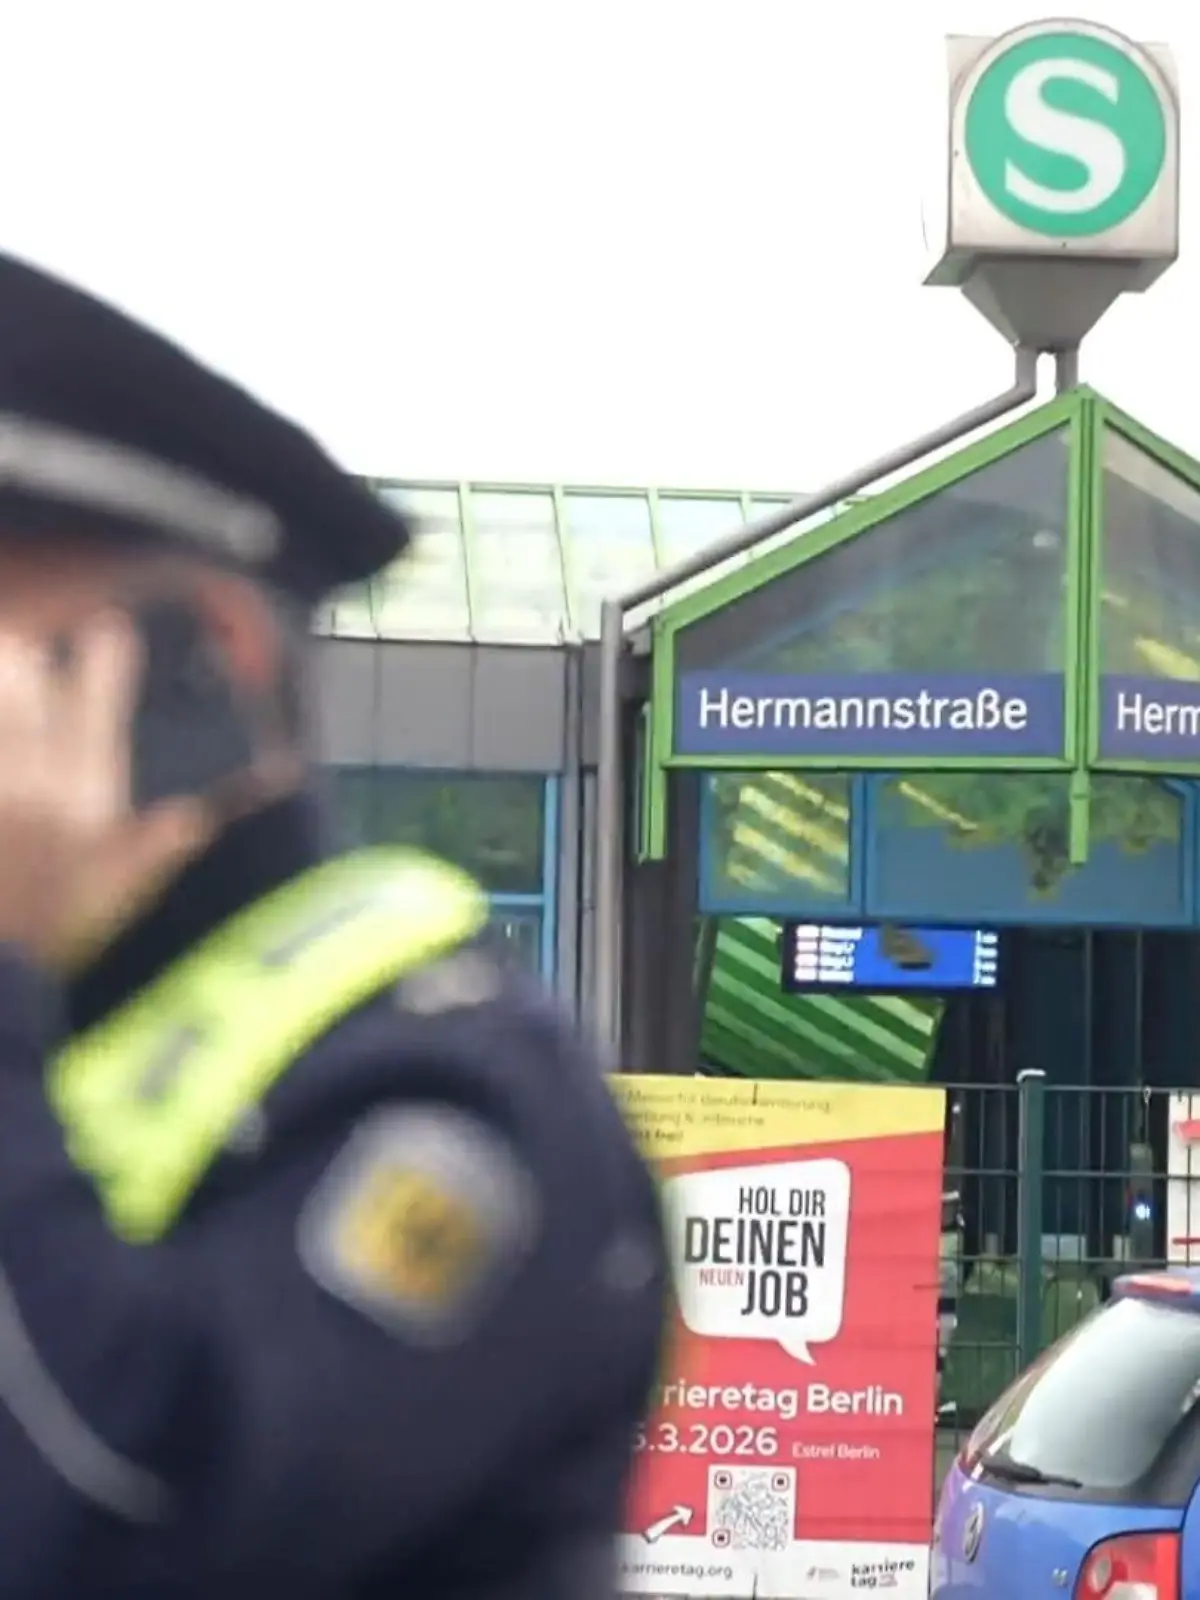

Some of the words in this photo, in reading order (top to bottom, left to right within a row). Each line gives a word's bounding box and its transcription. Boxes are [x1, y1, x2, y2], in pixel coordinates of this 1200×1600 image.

[1004, 57, 1126, 214] S
[699, 687, 1028, 730] Hermannstraße
[1118, 692, 1200, 735] Herm
[739, 1186, 781, 1216] HOL
[788, 1188, 826, 1217] DIR
[684, 1217, 826, 1267] DEINEN
[699, 1271, 744, 1287] NEUEN
[740, 1269, 809, 1318] JOB
[807, 1383, 903, 1416] Berlin
[837, 1443, 880, 1460] Berlin
